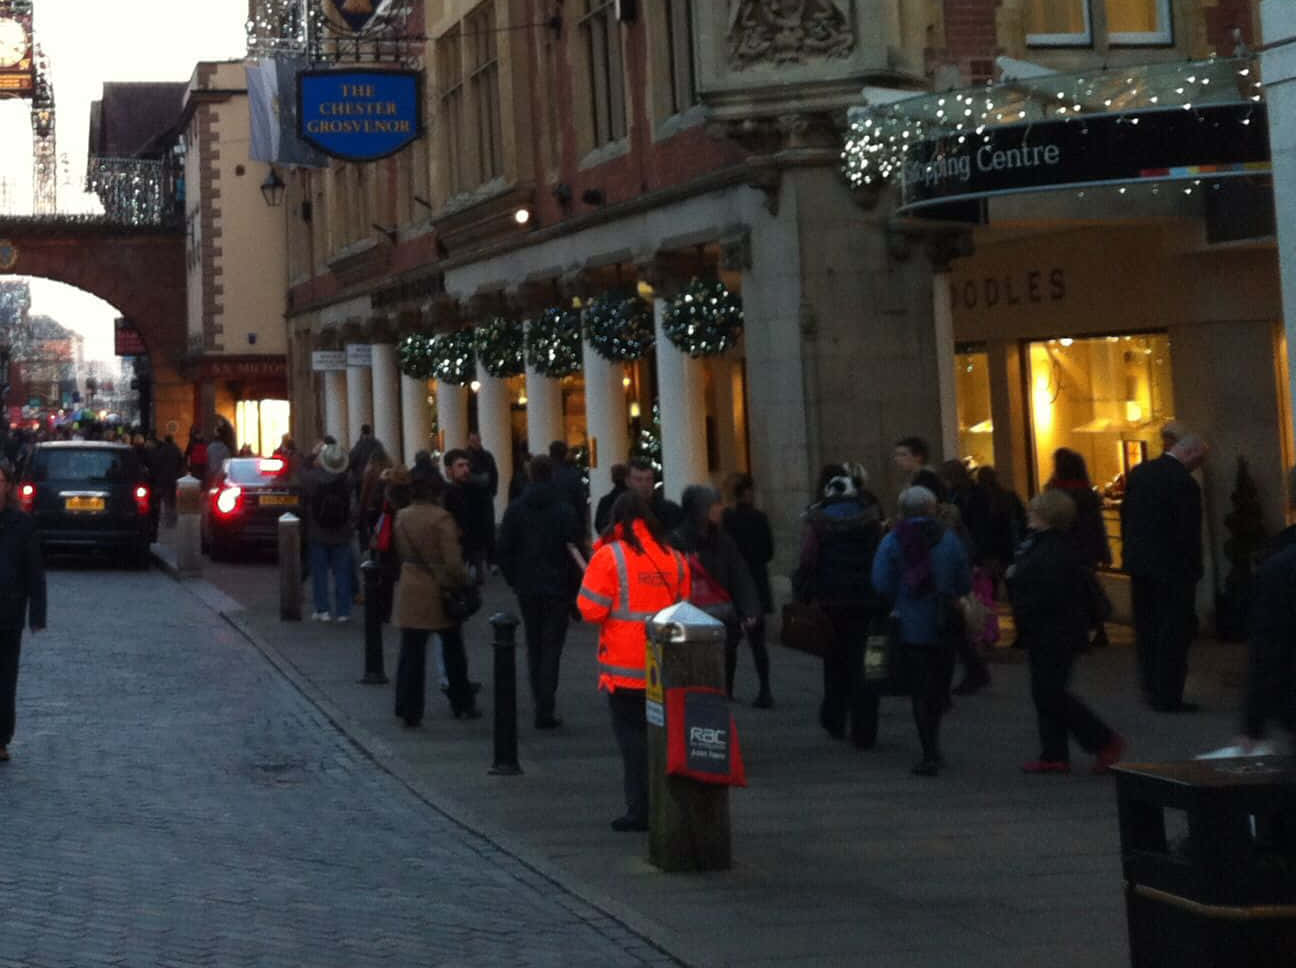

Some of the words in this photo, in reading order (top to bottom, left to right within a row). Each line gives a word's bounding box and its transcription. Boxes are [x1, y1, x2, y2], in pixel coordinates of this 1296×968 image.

[340, 84, 376, 97] THE
[319, 103, 397, 116] CHESTER
[306, 119, 410, 133] GROSVENOR
[976, 144, 1060, 172] Centre
